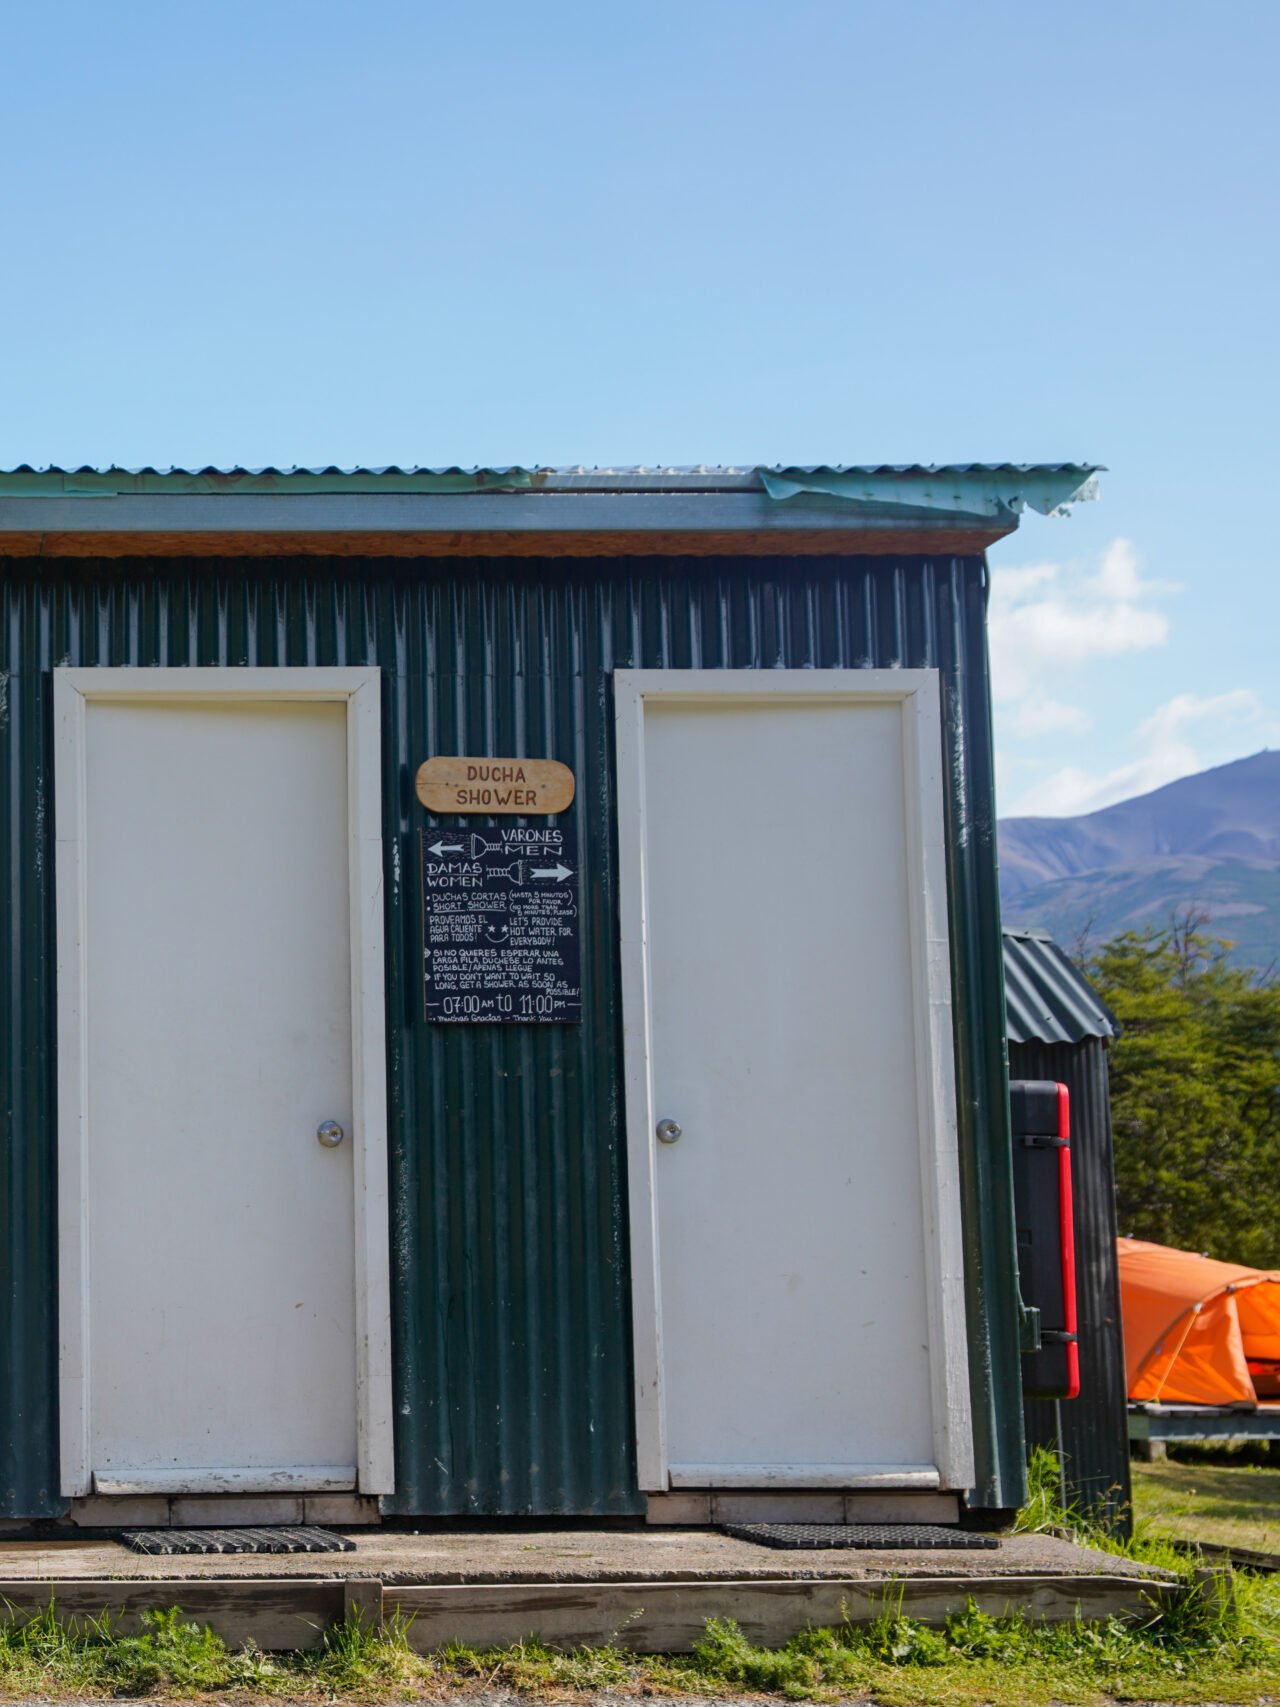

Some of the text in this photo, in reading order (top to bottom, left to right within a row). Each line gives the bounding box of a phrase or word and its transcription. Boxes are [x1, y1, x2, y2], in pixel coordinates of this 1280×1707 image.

[468, 766, 526, 783] DUCHA
[456, 789, 537, 806] SHOWER
[502, 830, 563, 842] VARONES
[505, 846, 562, 856] MEN
[426, 863, 482, 874] DAMAS
[427, 876, 482, 888] WOMEN
[432, 892, 468, 902] DUCHAS
[472, 892, 507, 900] CORTAS
[433, 902, 462, 911] SHORT
[468, 901, 507, 910] SHOWER
[430, 915, 488, 924] PROVEAMOS EL
[510, 917, 563, 926] LET'S PROVIDE
[430, 924, 482, 934] AGUA CALIENTE
[510, 927, 573, 936] HOT WATER FOR
[430, 934, 449, 942] PARA
[510, 937, 556, 946] EVERYBODY!
[459, 949, 498, 957] QUIERES
[544, 973, 556, 981] SO
[435, 982, 458, 990] LONG,
[460, 981, 475, 989] GET
[443, 996, 480, 1014] 07:00
[519, 995, 553, 1014] 11:00
